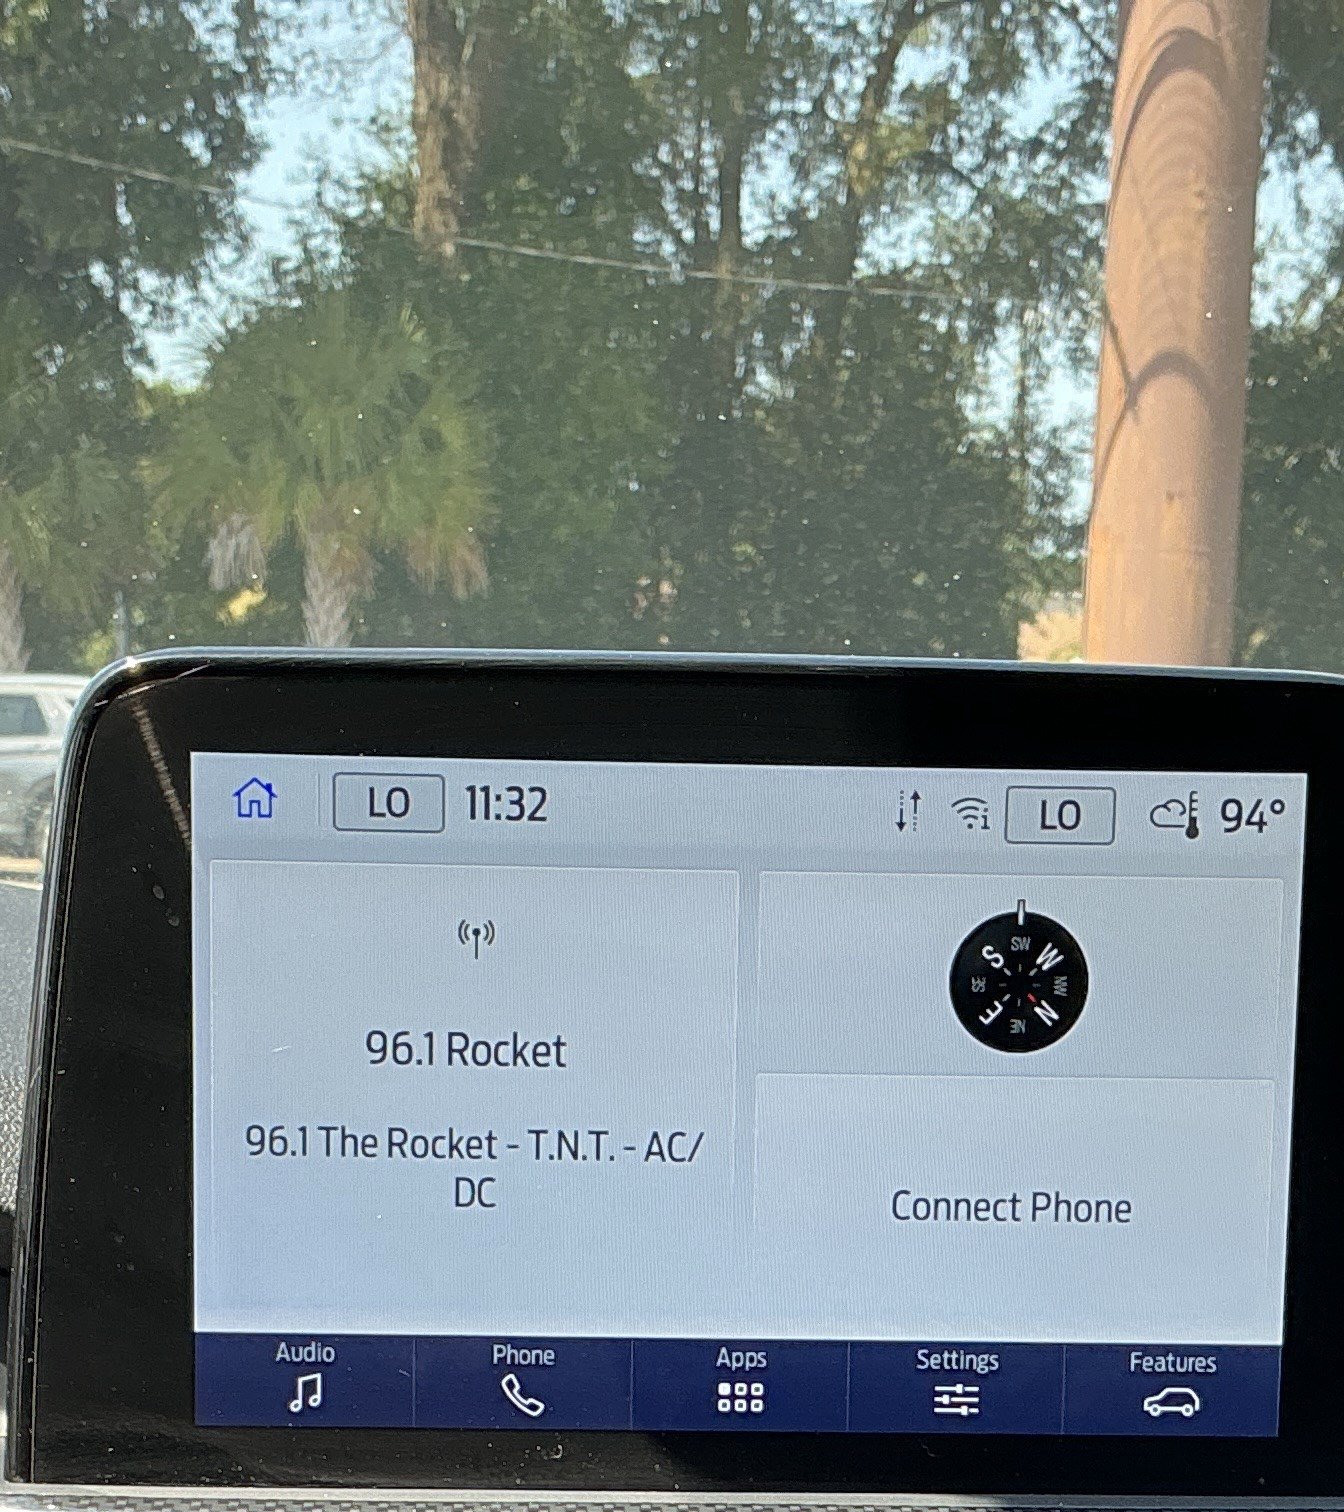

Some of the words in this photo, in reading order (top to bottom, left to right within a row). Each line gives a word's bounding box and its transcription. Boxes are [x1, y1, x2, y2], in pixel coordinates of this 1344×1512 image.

[367, 786, 411, 819] LO
[464, 784, 548, 822] 11:32
[1040, 799, 1081, 831] LO
[1220, 798, 1286, 834] 94°
[981, 944, 1005, 970] S
[1035, 941, 1065, 972] W
[978, 1000, 1004, 1026] E
[1033, 999, 1061, 1028] N
[365, 1029, 434, 1066] 96.1
[447, 1030, 567, 1068] Rocket
[245, 1124, 308, 1157] 96.1
[316, 1124, 378, 1158] The
[387, 1126, 498, 1160] Rocket
[527, 1128, 615, 1162] T.N.T.
[643, 1130, 705, 1163] AC/
[454, 1176, 497, 1208] DC
[891, 1189, 1022, 1222] Connect
[1031, 1190, 1132, 1224] Phone
[275, 1340, 336, 1363] Audio
[492, 1343, 555, 1366] Phone
[715, 1346, 768, 1372] Apps
[916, 1348, 1000, 1375] Settings
[1130, 1351, 1217, 1374] Features
